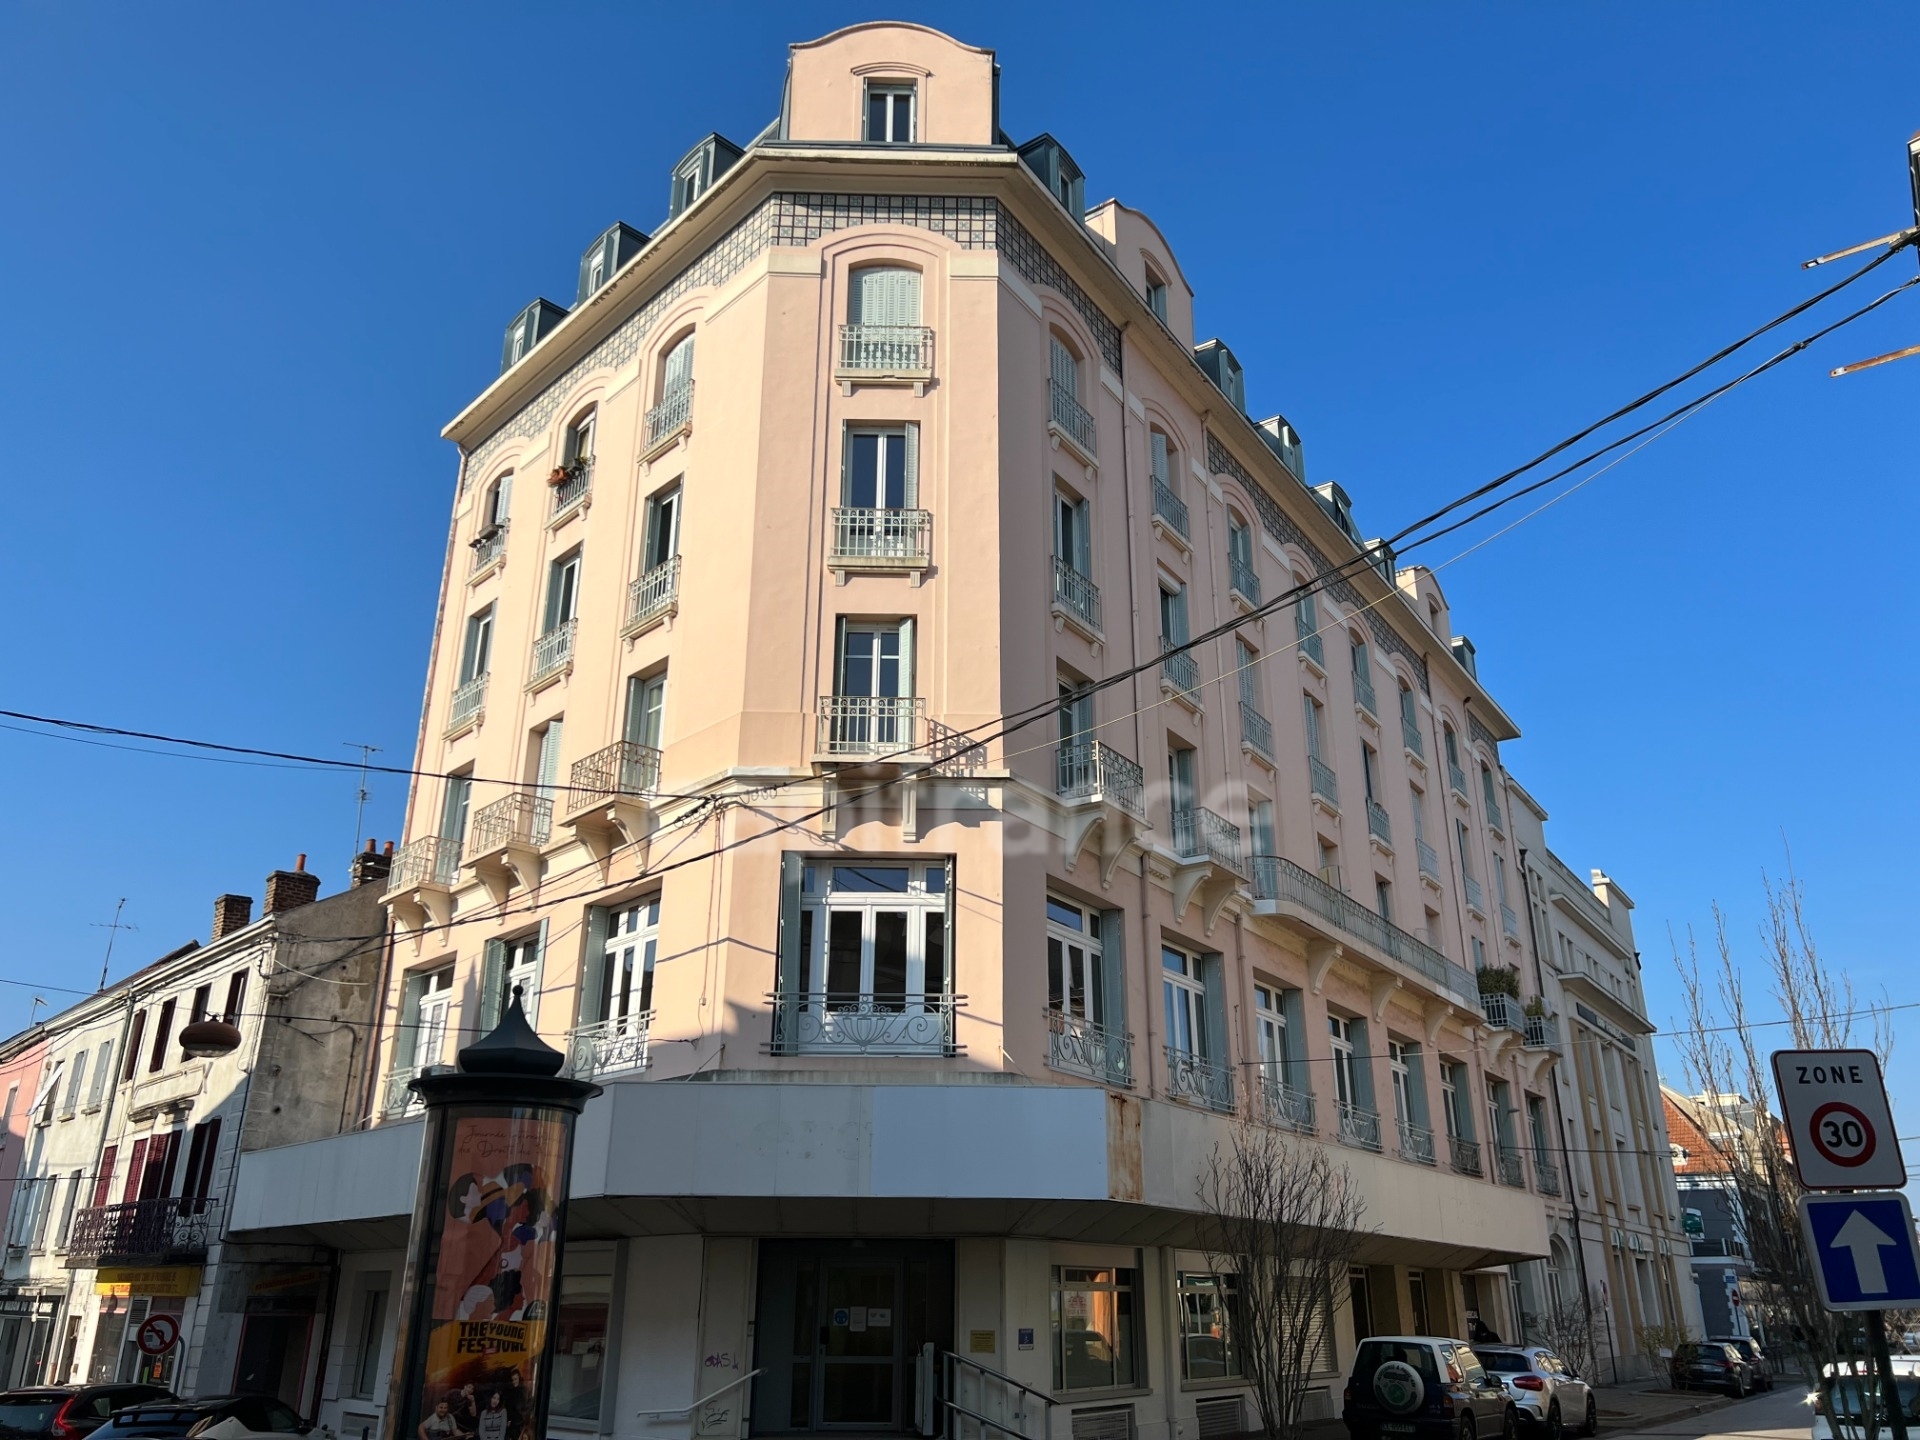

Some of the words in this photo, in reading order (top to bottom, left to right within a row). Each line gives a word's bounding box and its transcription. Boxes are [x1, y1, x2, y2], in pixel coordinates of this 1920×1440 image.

[1796, 1065, 1863, 1084] ZONE
[1823, 1120, 1863, 1148] 30
[460, 1322, 488, 1338] THE
[489, 1322, 526, 1340] YOUNG
[456, 1337, 527, 1354] FESTIVAL
